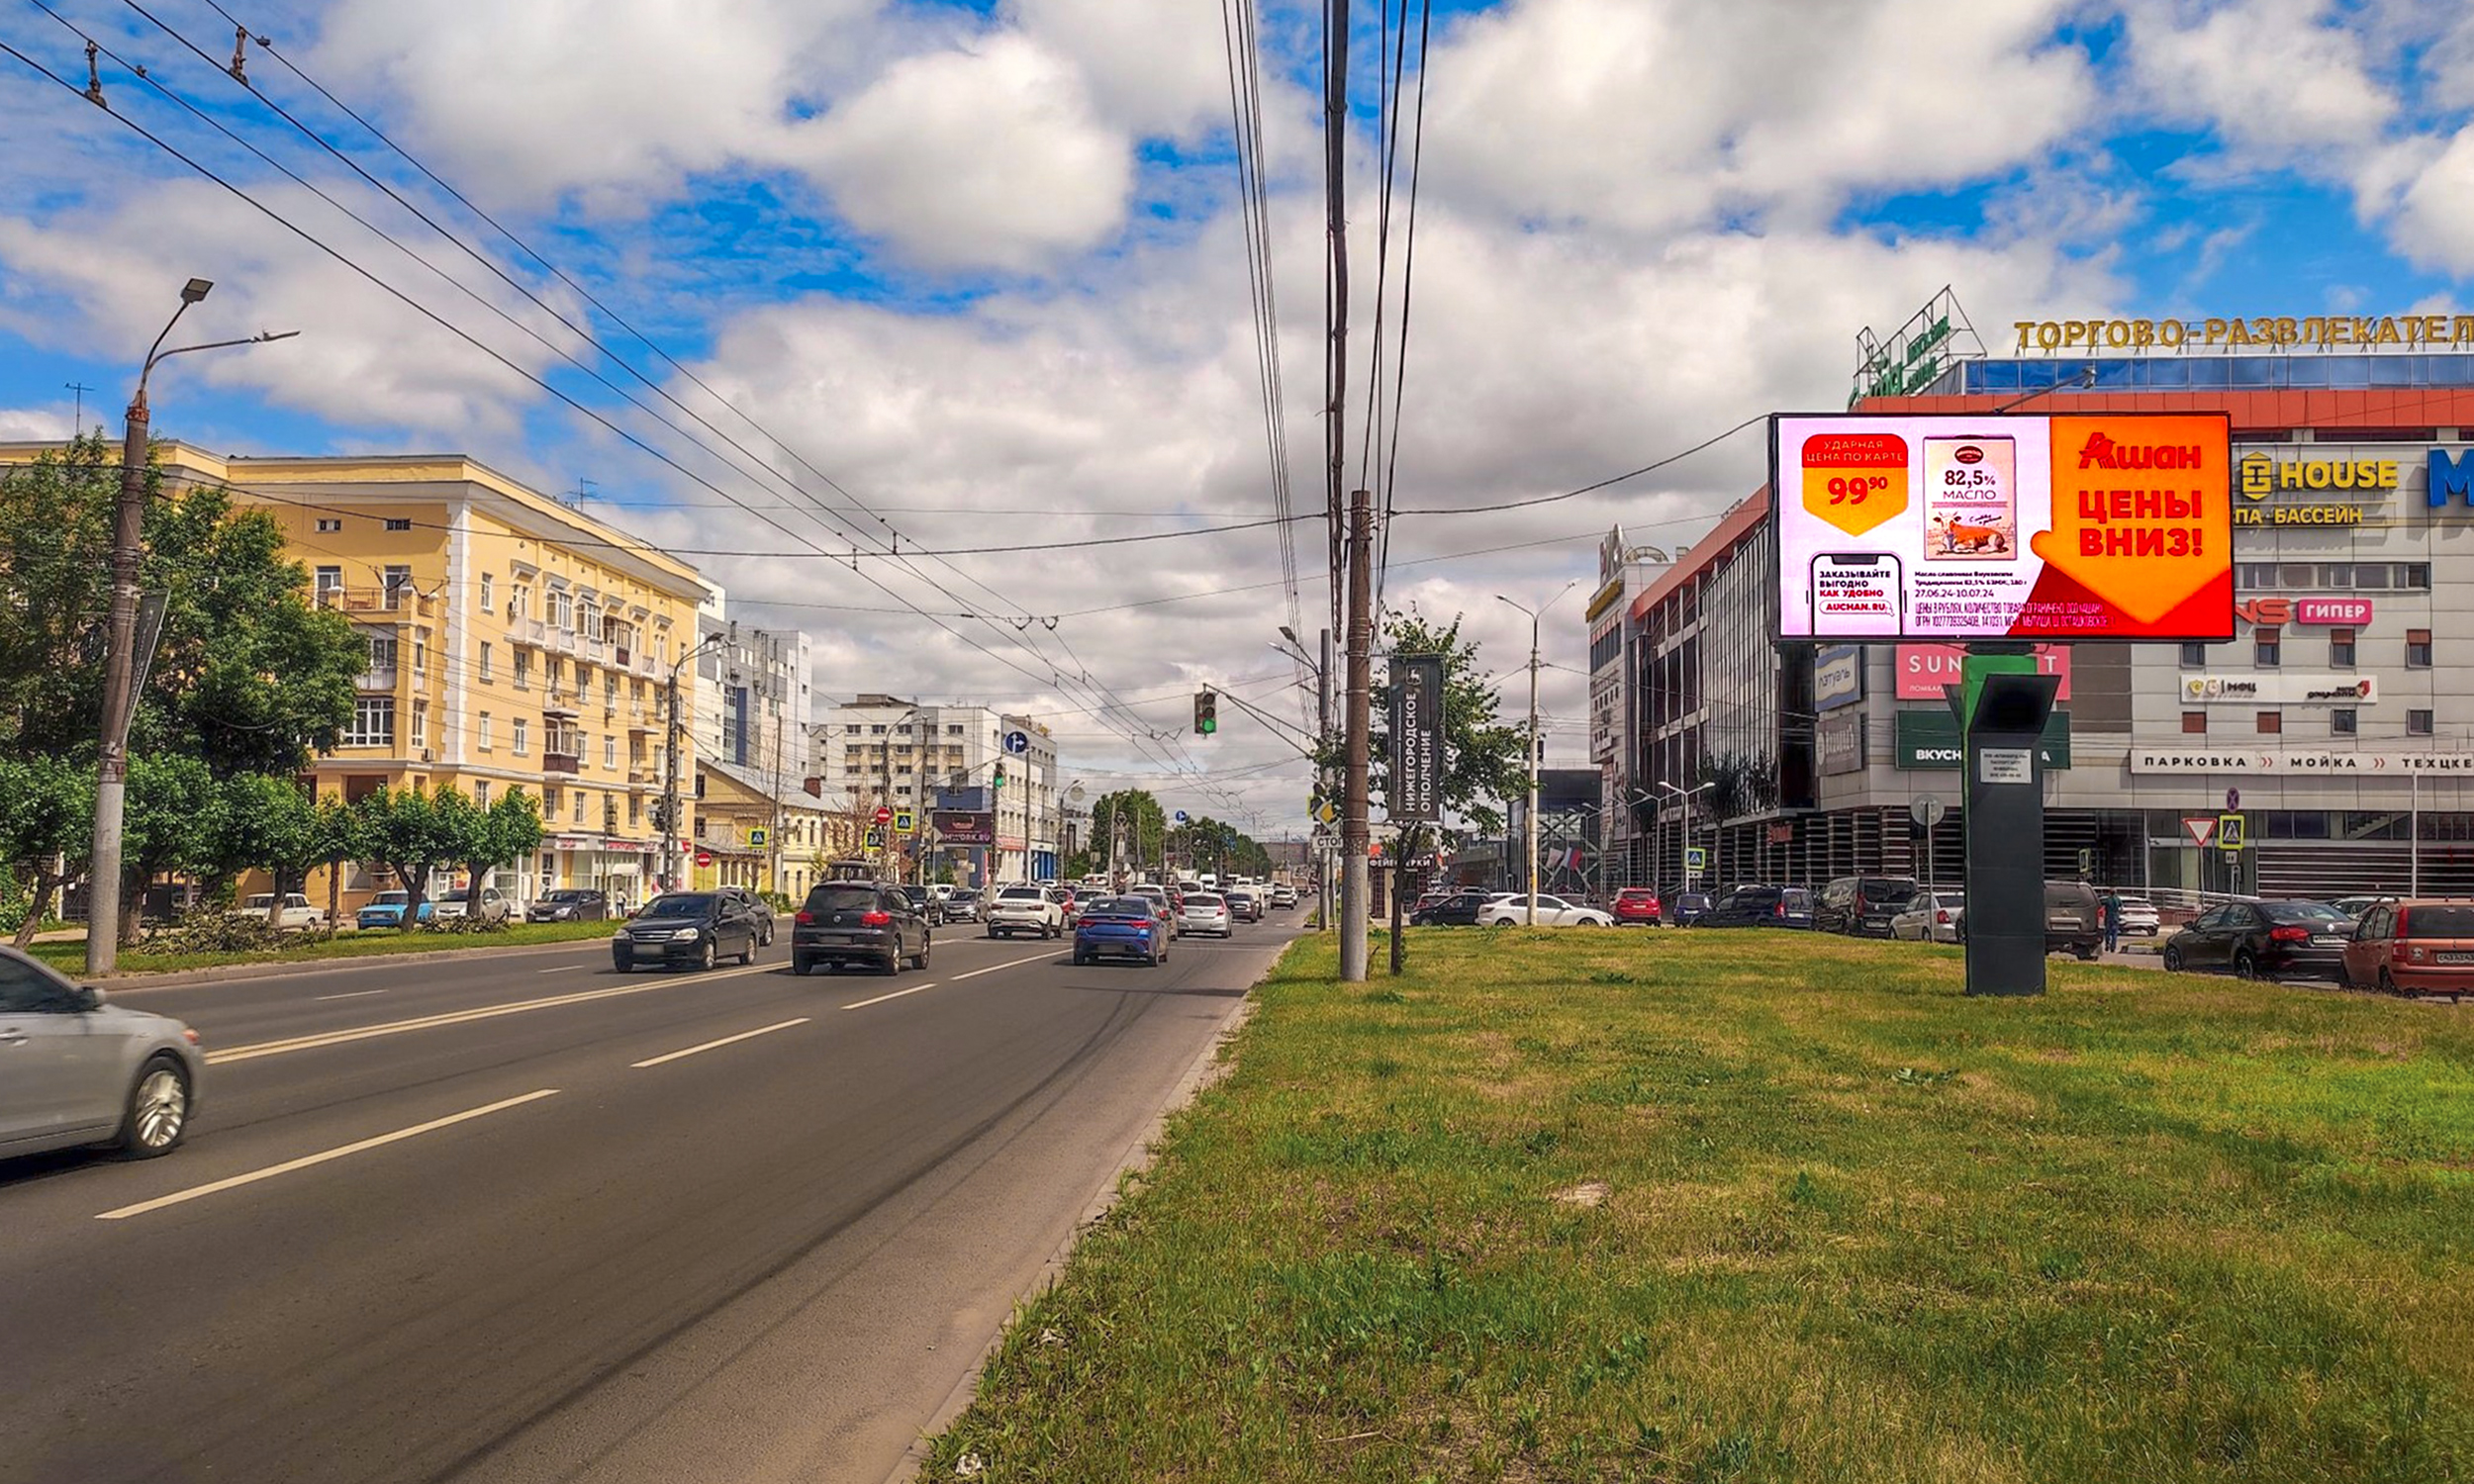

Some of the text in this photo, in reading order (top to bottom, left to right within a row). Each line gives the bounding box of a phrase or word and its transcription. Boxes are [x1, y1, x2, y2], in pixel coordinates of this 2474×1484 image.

[1824, 440, 1883, 450] УДАРНАЯ
[1806, 453, 1841, 463] ЦЕНА
[1945, 470, 1996, 489] 82,5%
[2279, 459, 2399, 489] HOUSE
[1943, 490, 1997, 500] МАСЛО
[2078, 490, 2202, 524] ЦЕНЫ
[2235, 506, 2363, 524] ПА БАССЕЙН
[2079, 527, 2203, 557] ВНИЗ!
[1819, 569, 1891, 578] ЗАКАЗЫВАЙТЕ
[1819, 580, 1869, 589] ВЫГОДНО
[1843, 590, 1884, 599] УДОБНО
[1826, 603, 1885, 611] AUCHAN.RU
[2236, 599, 2292, 624] NS
[2306, 604, 2366, 618] ГИПЕР
[1908, 655, 2057, 673] SUNT
[1405, 693, 1418, 811] НИЖЕГОРОДСКОЕ
[1916, 749, 1961, 761] ВКУСН
[2143, 756, 2247, 767] ПАРКОВКА
[2290, 754, 2357, 768] МОЙКА
[1420, 729, 1432, 812] ОПОЛЧЕНИЕ
[1369, 858, 1430, 867] ФЕЙЕРКИ
